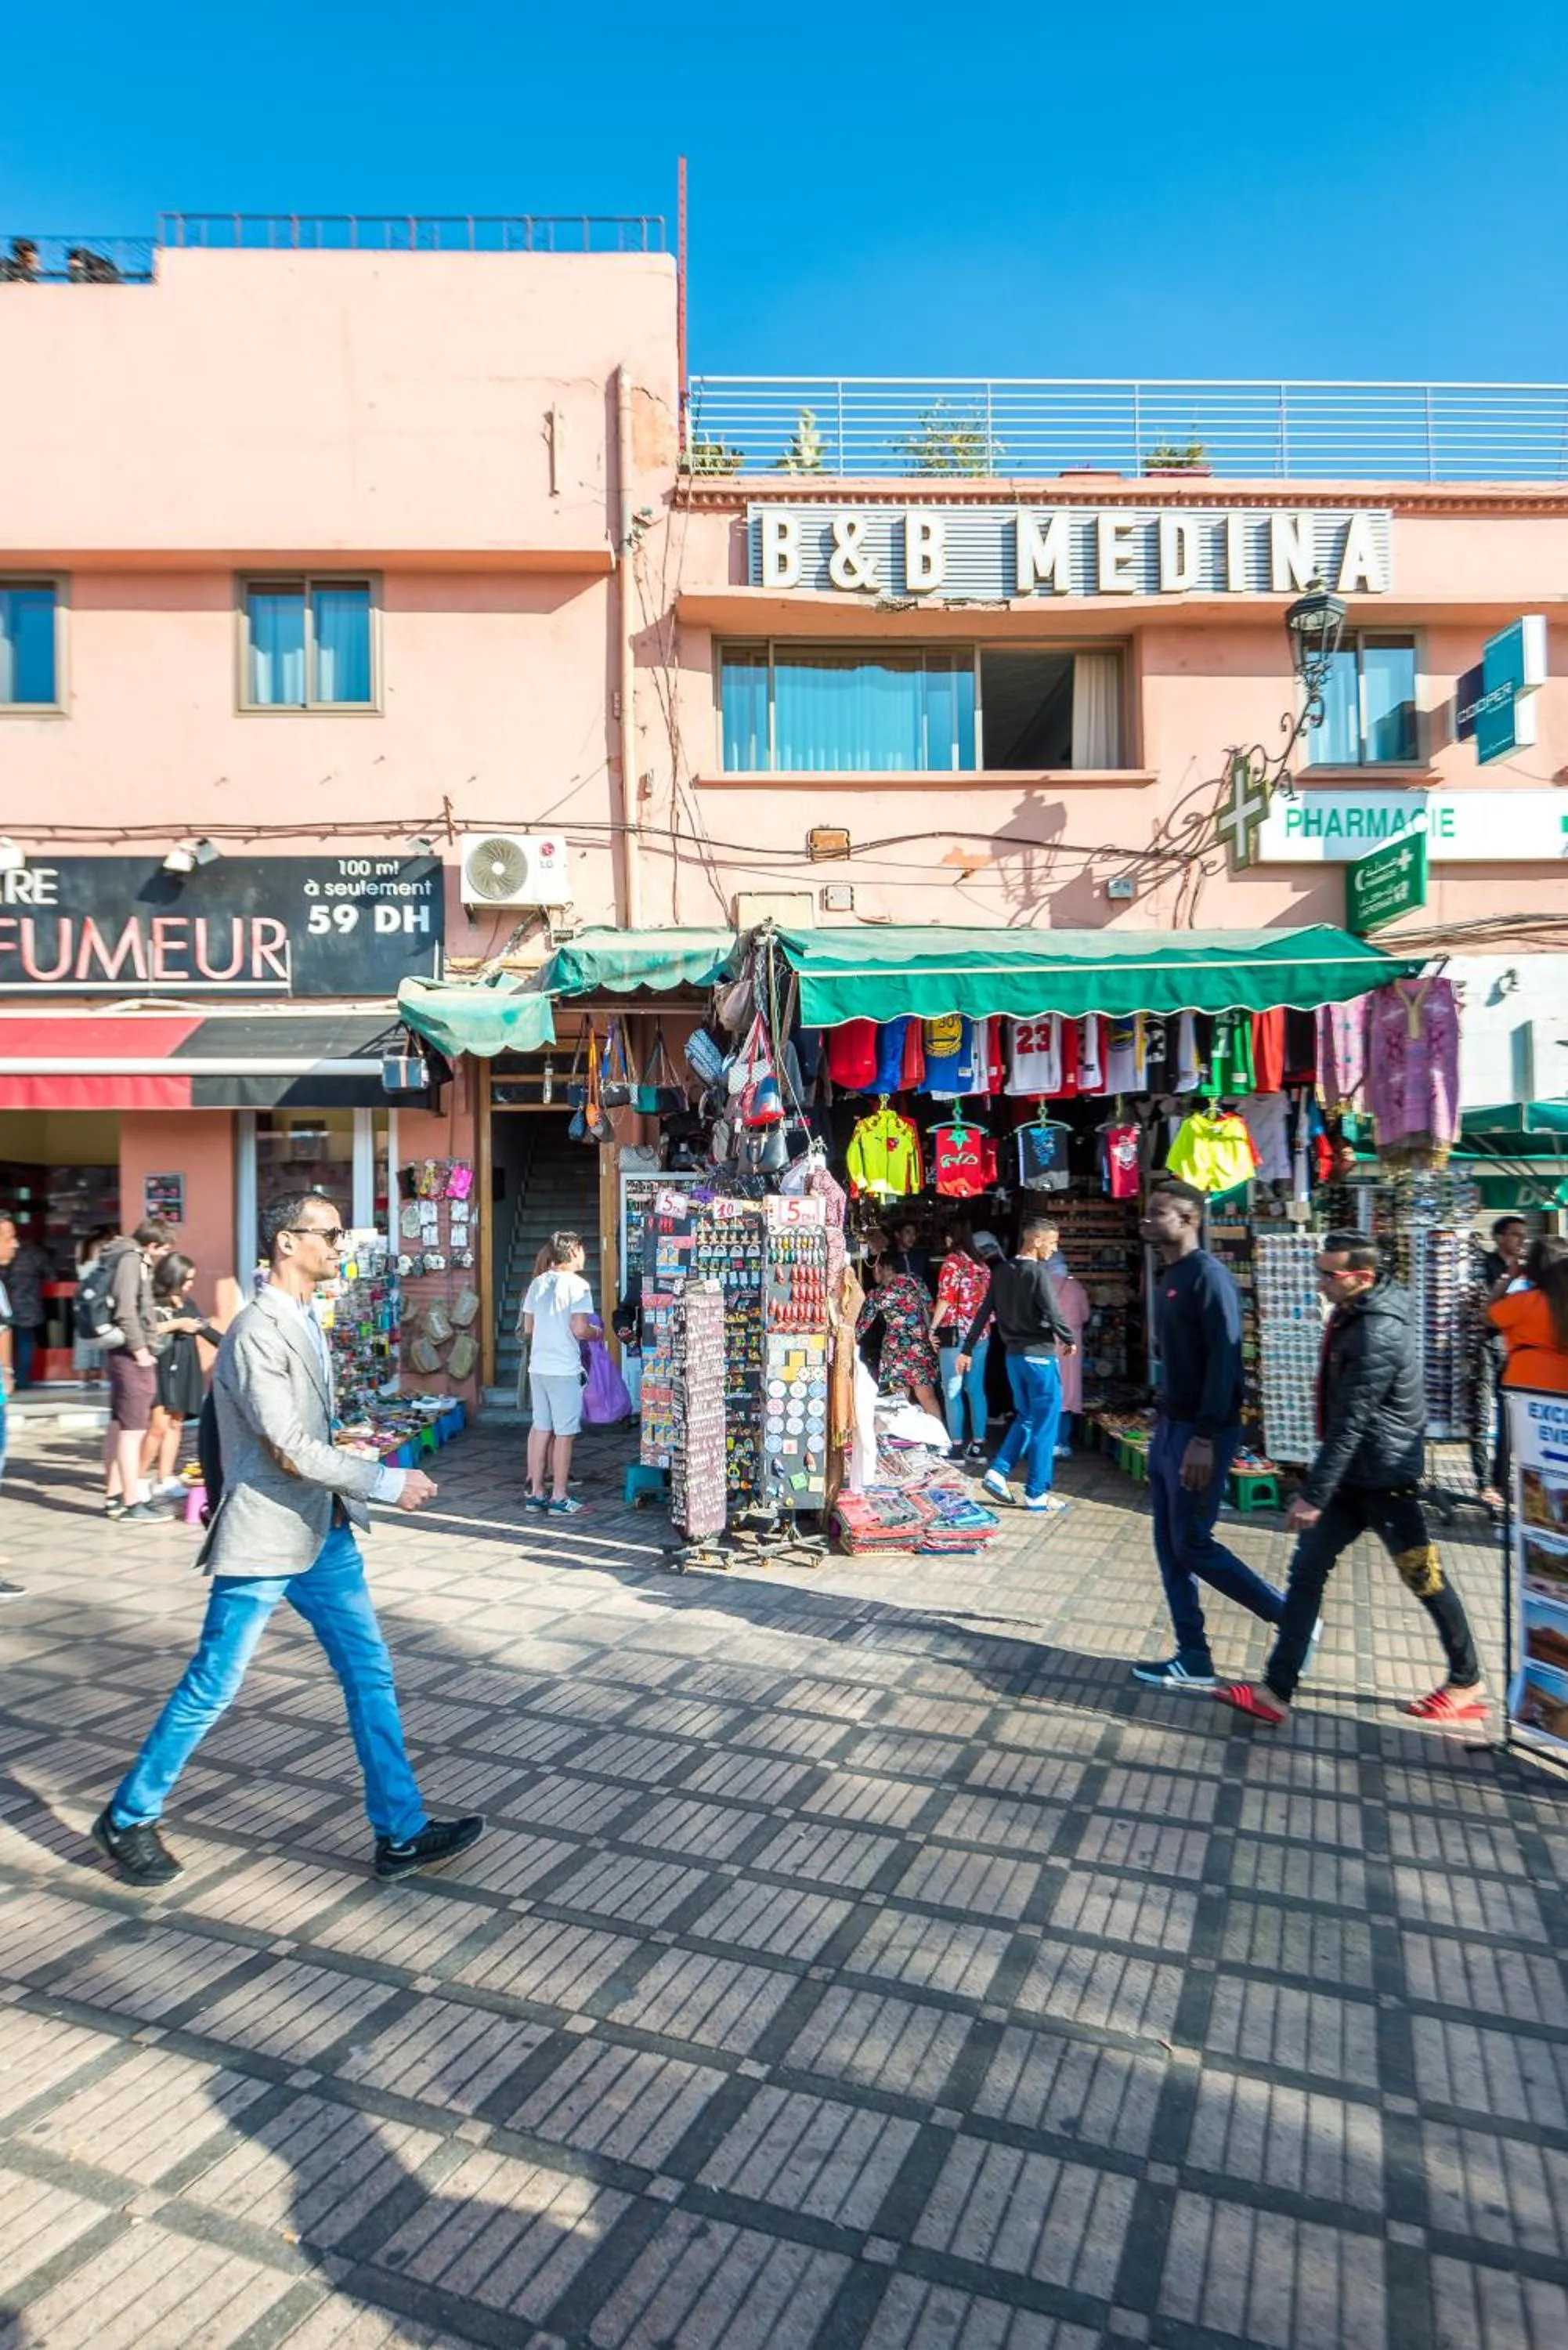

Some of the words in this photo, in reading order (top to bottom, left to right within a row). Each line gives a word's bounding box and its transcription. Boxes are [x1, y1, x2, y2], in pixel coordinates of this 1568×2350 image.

[762, 510, 801, 589] B
[829, 512, 880, 593] &
[905, 511, 945, 592] B
[1016, 511, 1389, 594] MEDINA
[338, 859, 371, 876] 100
[375, 859, 399, 876] ml
[0, 868, 59, 906] RE
[303, 878, 320, 896] à
[323, 879, 433, 896] seulement
[307, 903, 359, 935] 59
[374, 904, 431, 934] DH
[1016, 1023, 1051, 1054] 23
[662, 1195, 673, 1211] 5
[787, 1200, 800, 1222] 5
